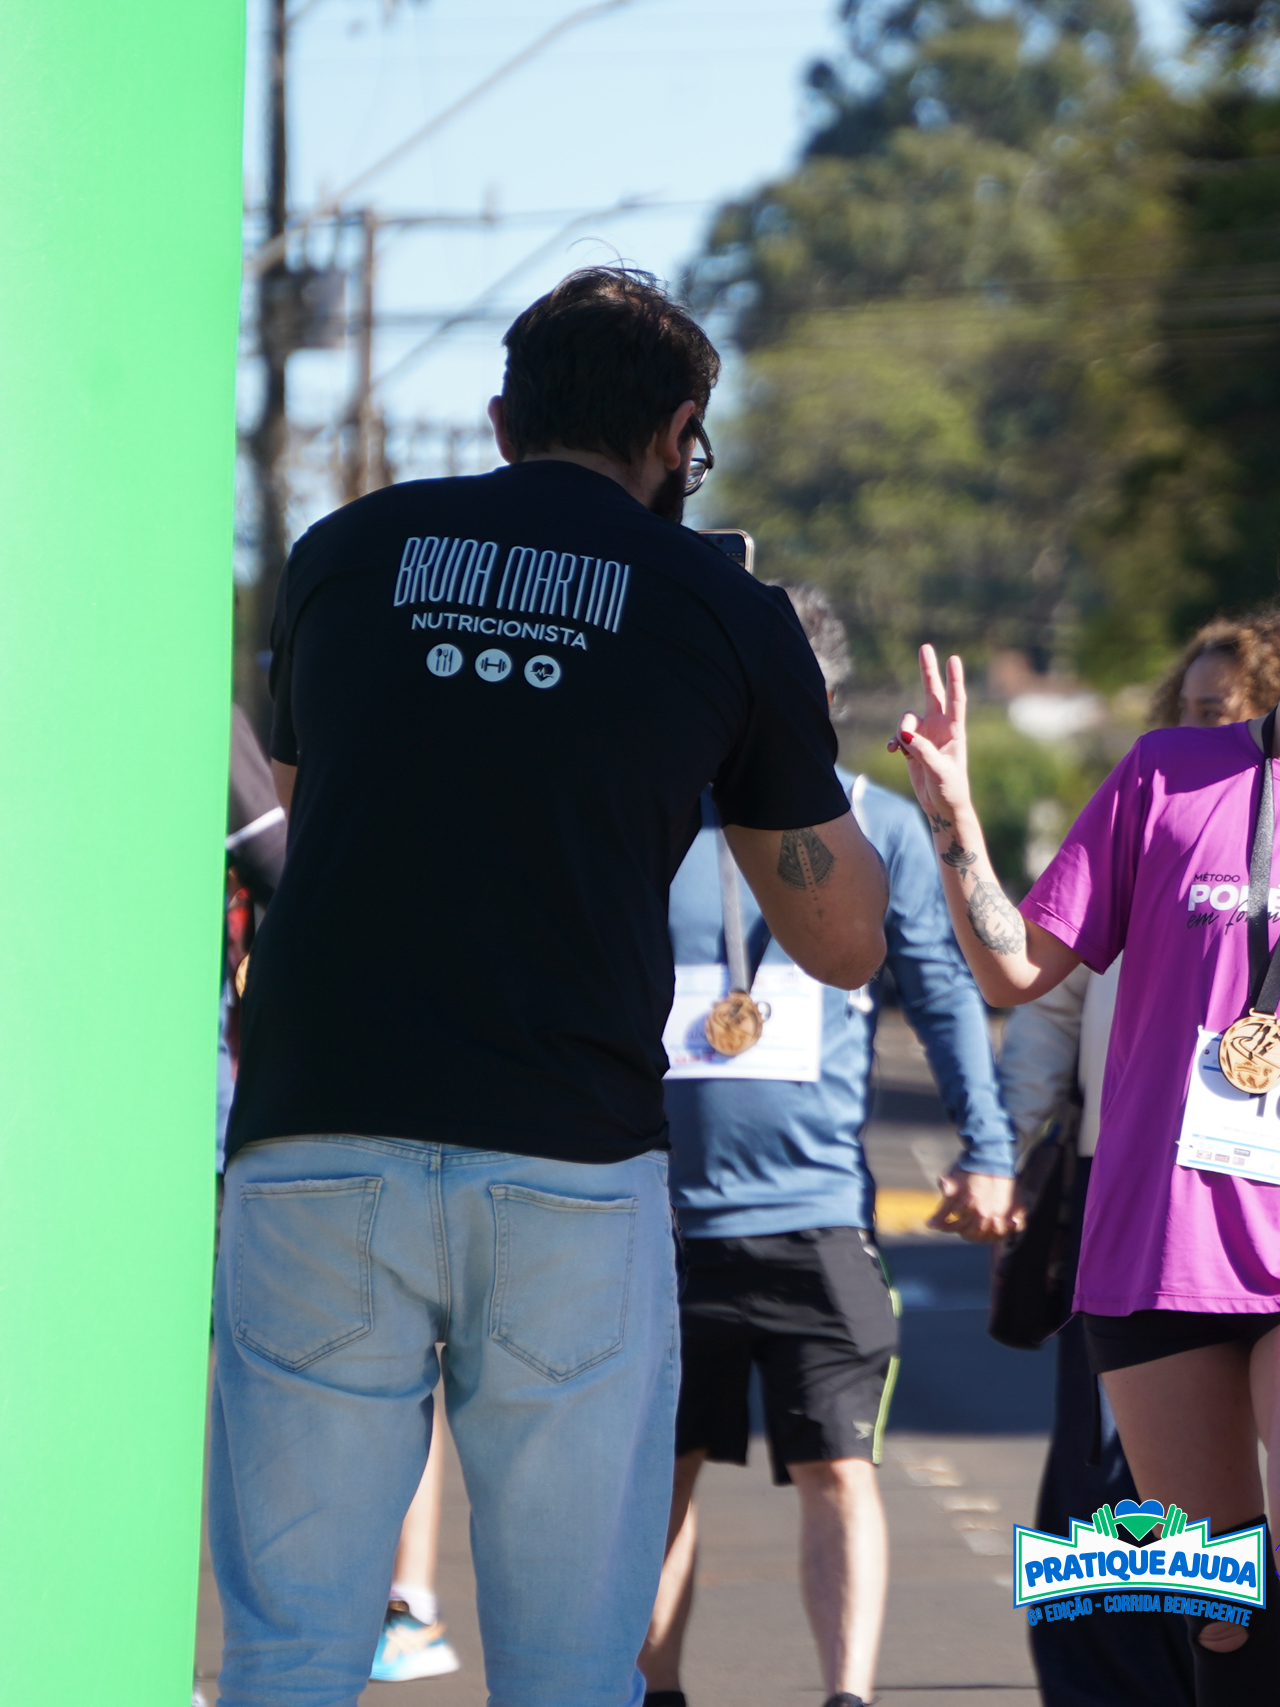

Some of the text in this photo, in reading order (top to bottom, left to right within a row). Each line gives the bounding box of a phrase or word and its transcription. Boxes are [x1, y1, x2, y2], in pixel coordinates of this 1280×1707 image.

[393, 536, 630, 634] BRUNA MARTINI
[411, 612, 587, 651] NUTRICIONISTA
[1193, 871, 1241, 883] MÉTODO
